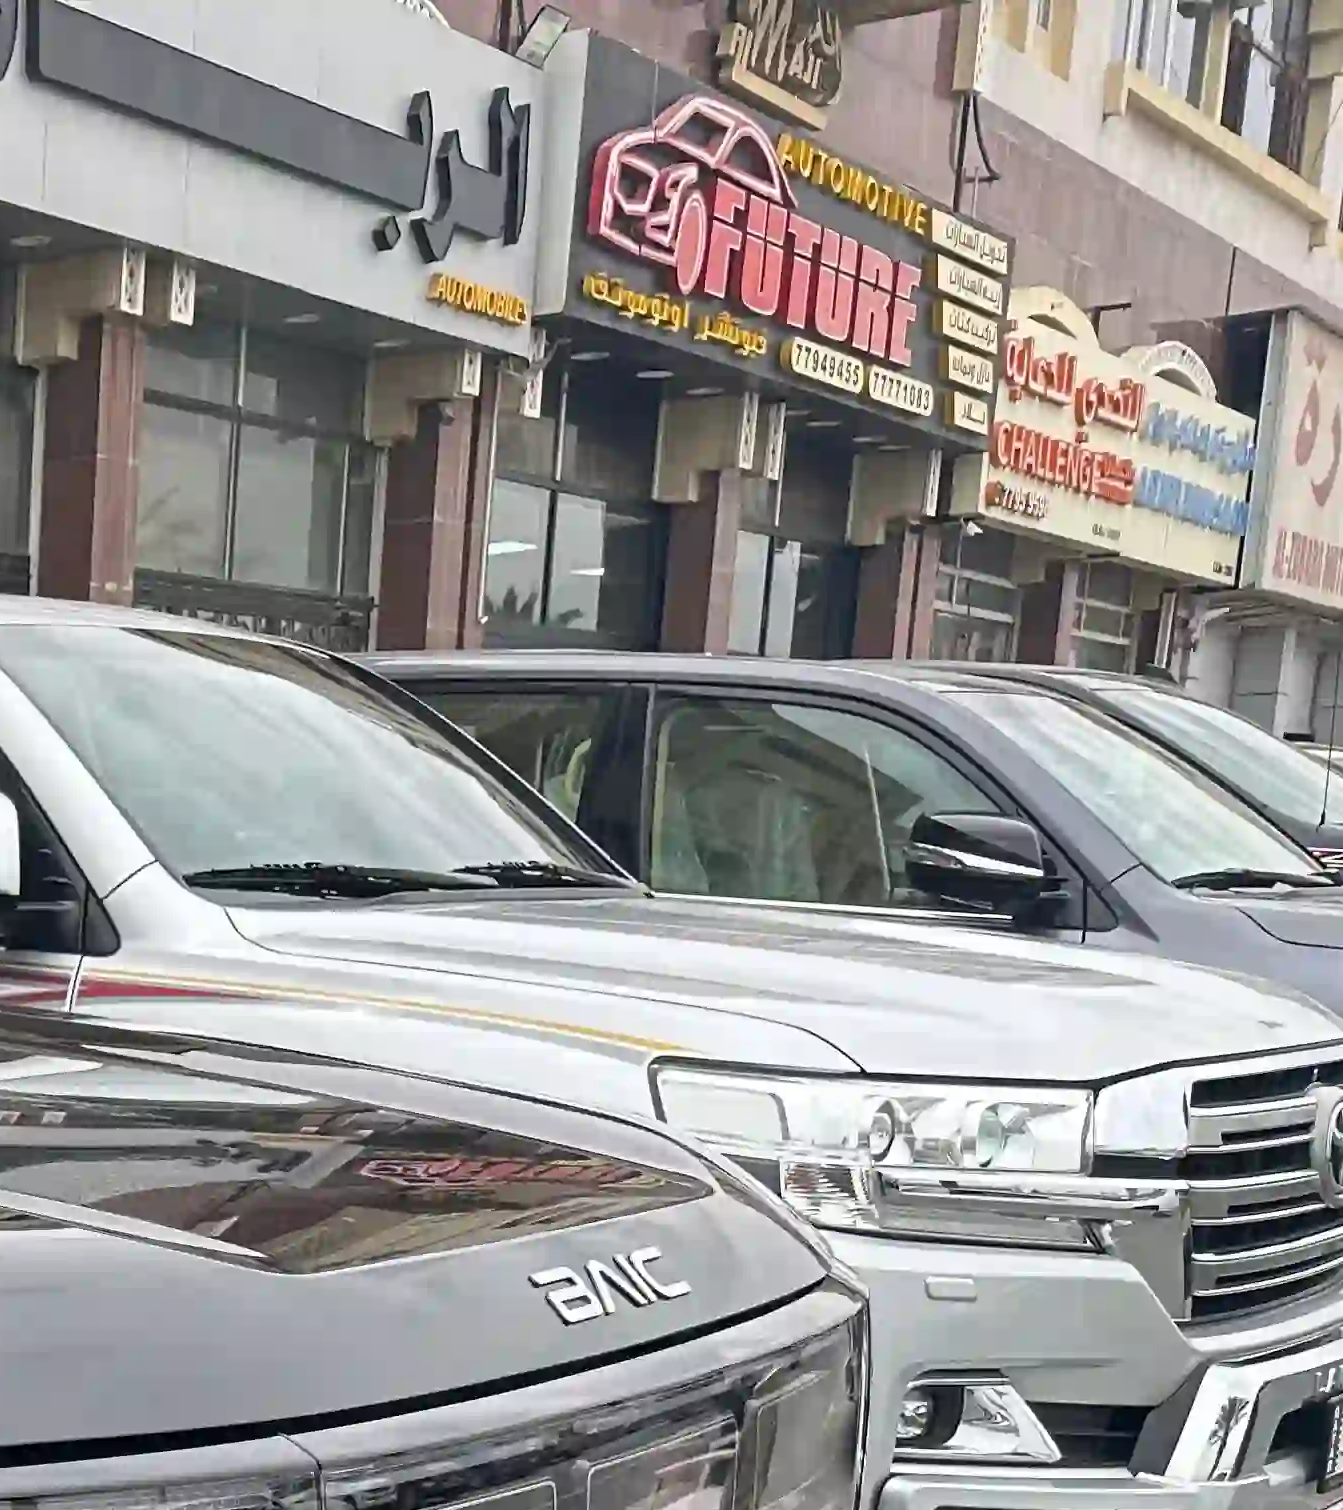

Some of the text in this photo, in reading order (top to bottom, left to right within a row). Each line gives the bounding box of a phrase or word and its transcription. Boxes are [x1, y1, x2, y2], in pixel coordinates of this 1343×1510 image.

[778, 133, 927, 236] AUTOMOTIVE
[704, 177, 922, 367] FUTURE
[795, 343, 860, 387] 77949455
[873, 372, 930, 410] 77771083
[991, 420, 1103, 497] CHALLENGE
[528, 1244, 692, 1326] BAIC
